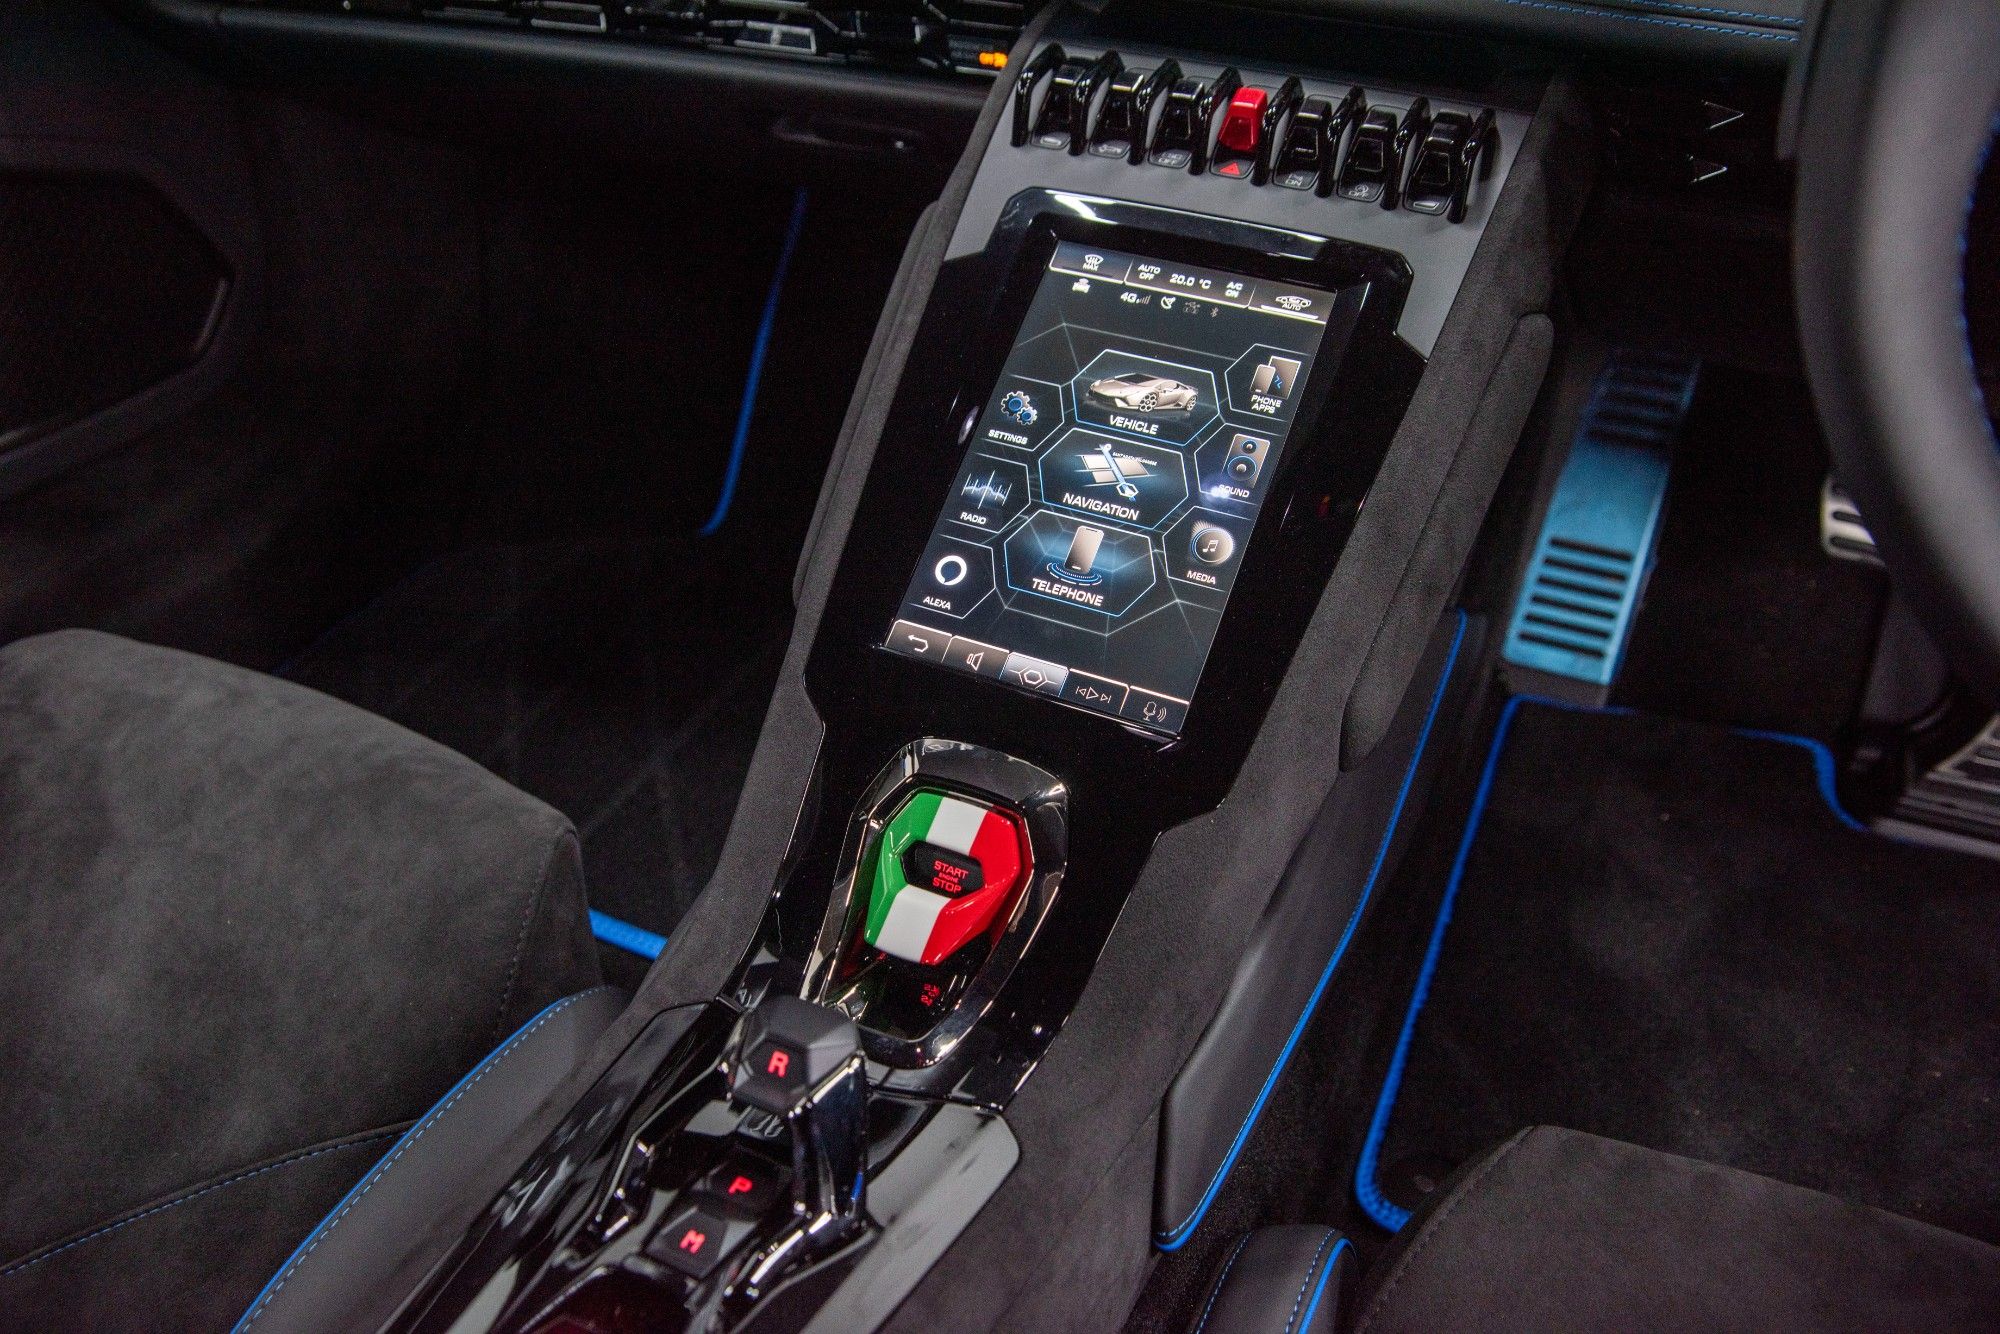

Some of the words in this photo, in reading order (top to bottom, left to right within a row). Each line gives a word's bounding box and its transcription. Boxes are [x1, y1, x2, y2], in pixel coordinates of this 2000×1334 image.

[1083, 263, 1099, 272] MAX
[1138, 264, 1161, 274] AUTO
[1139, 272, 1155, 281] OFF
[1169, 274, 1195, 287] 20.0
[1226, 281, 1243, 291] A/C
[1120, 292, 1137, 303] 4G
[1225, 289, 1239, 298] ON
[1282, 302, 1302, 311] AUTO
[1251, 394, 1283, 408] PHONE
[1251, 401, 1276, 414] APPS
[1109, 414, 1159, 436] VEHICLE
[988, 429, 1028, 445] SETTINGS
[1219, 484, 1250, 498] SOUND
[1062, 492, 1140, 521] NAVIGATION
[960, 512, 987, 525] RADIO
[1186, 570, 1216, 585] MEDIA
[1032, 578, 1104, 607] TELEPHONE
[923, 596, 952, 610] ALEXA
[934, 860, 969, 878] START
[932, 877, 962, 893] STOP
[767, 1050, 790, 1079] R
[728, 1175, 753, 1195] P
[680, 1229, 707, 1254] M
